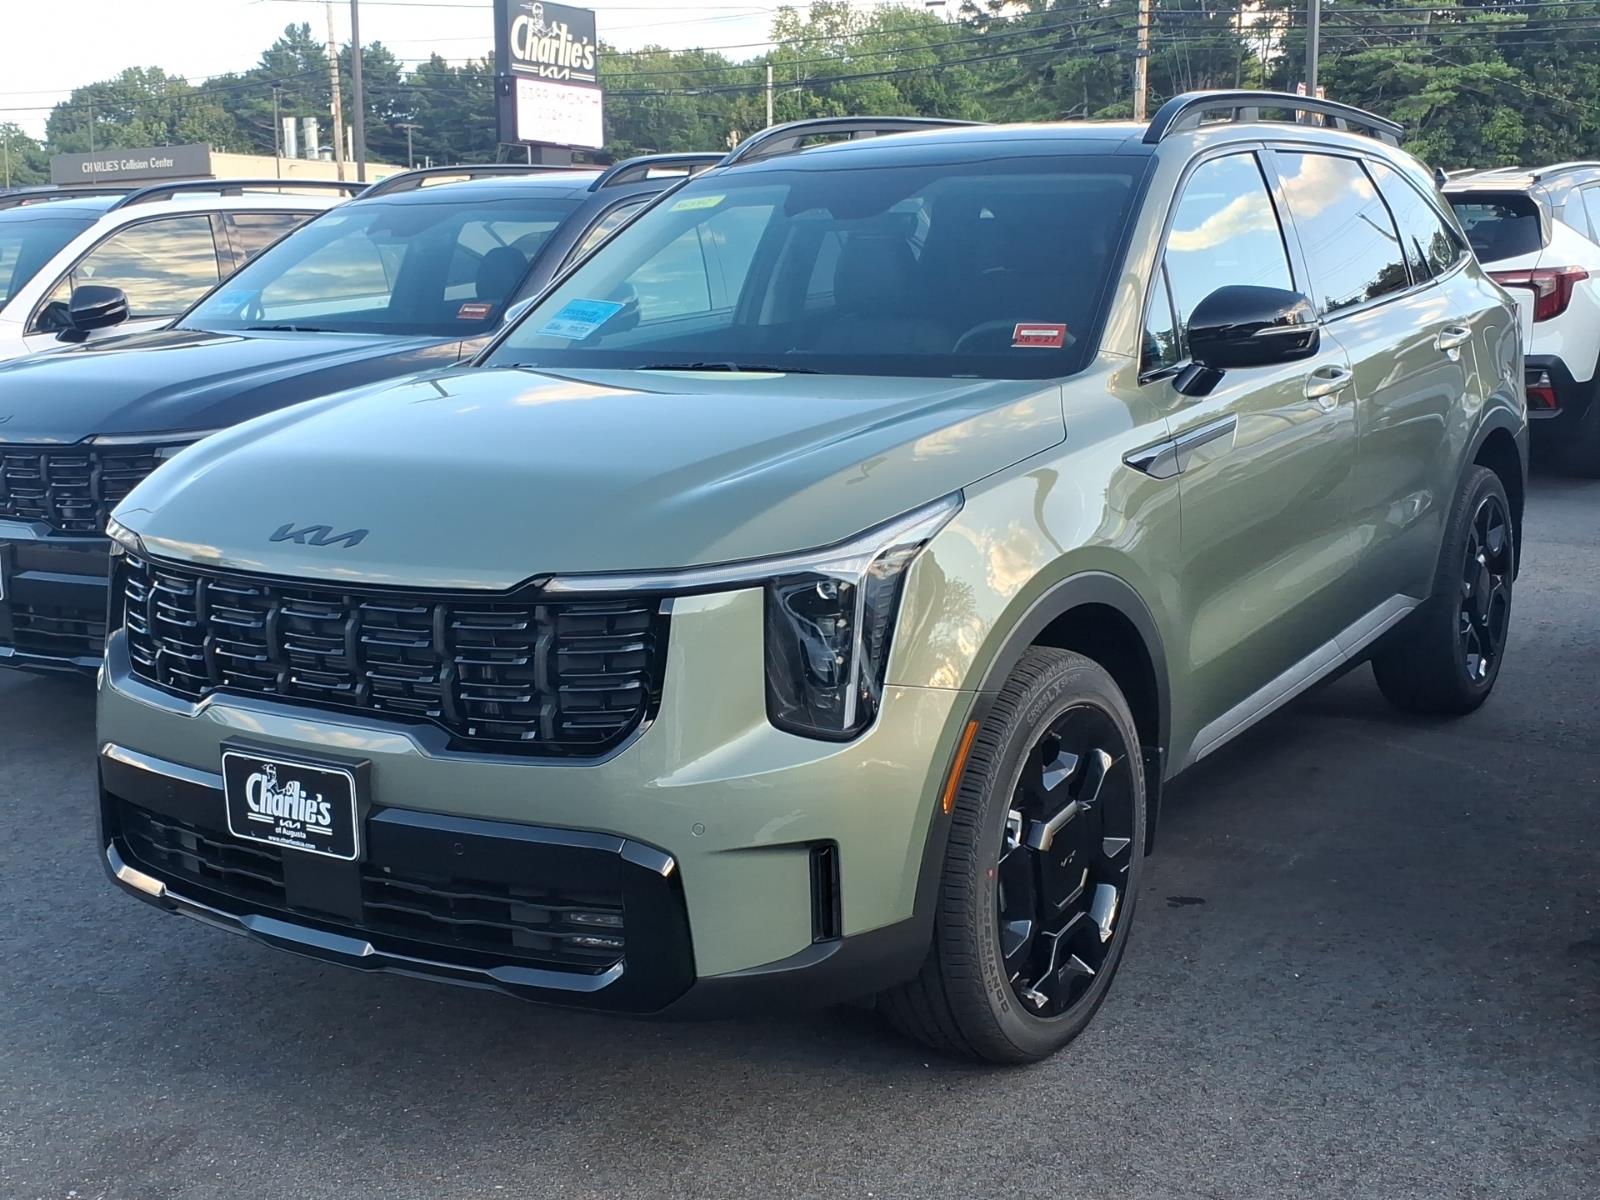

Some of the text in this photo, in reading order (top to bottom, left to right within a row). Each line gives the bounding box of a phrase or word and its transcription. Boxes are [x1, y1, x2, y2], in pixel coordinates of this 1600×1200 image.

[511, 14, 595, 70] Charlie's
[539, 65, 571, 80] KIA
[120, 159, 148, 171] Collision
[150, 157, 174, 169] Center
[269, 522, 370, 549] KIA
[245, 772, 331, 826] Charlie's
[279, 818, 301, 829] KIA
[282, 827, 307, 839] Augusta
